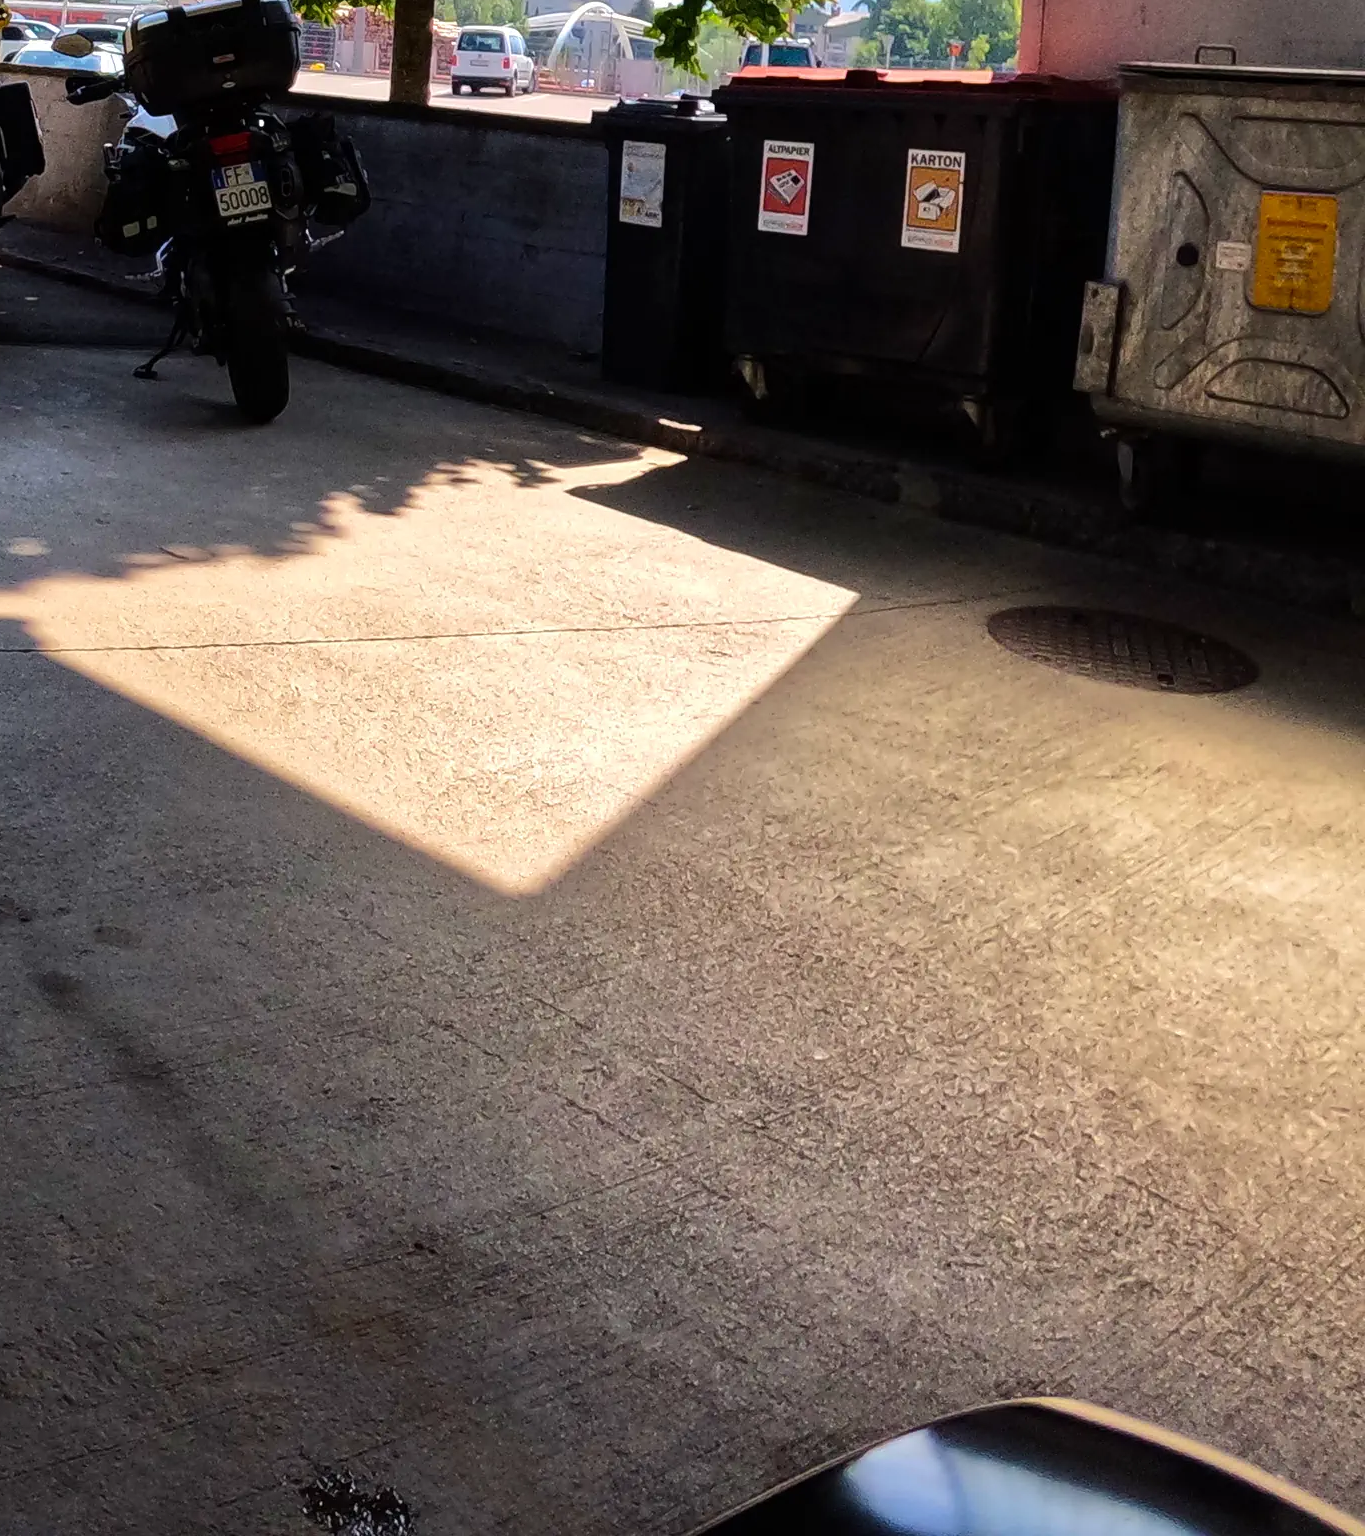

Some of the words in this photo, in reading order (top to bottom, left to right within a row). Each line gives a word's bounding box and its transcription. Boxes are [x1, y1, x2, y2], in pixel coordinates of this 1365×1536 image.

[768, 145, 810, 156] ALTPAPIER
[911, 153, 962, 168] KARTON
[224, 165, 242, 186] FF
[220, 186, 269, 212] 50008
